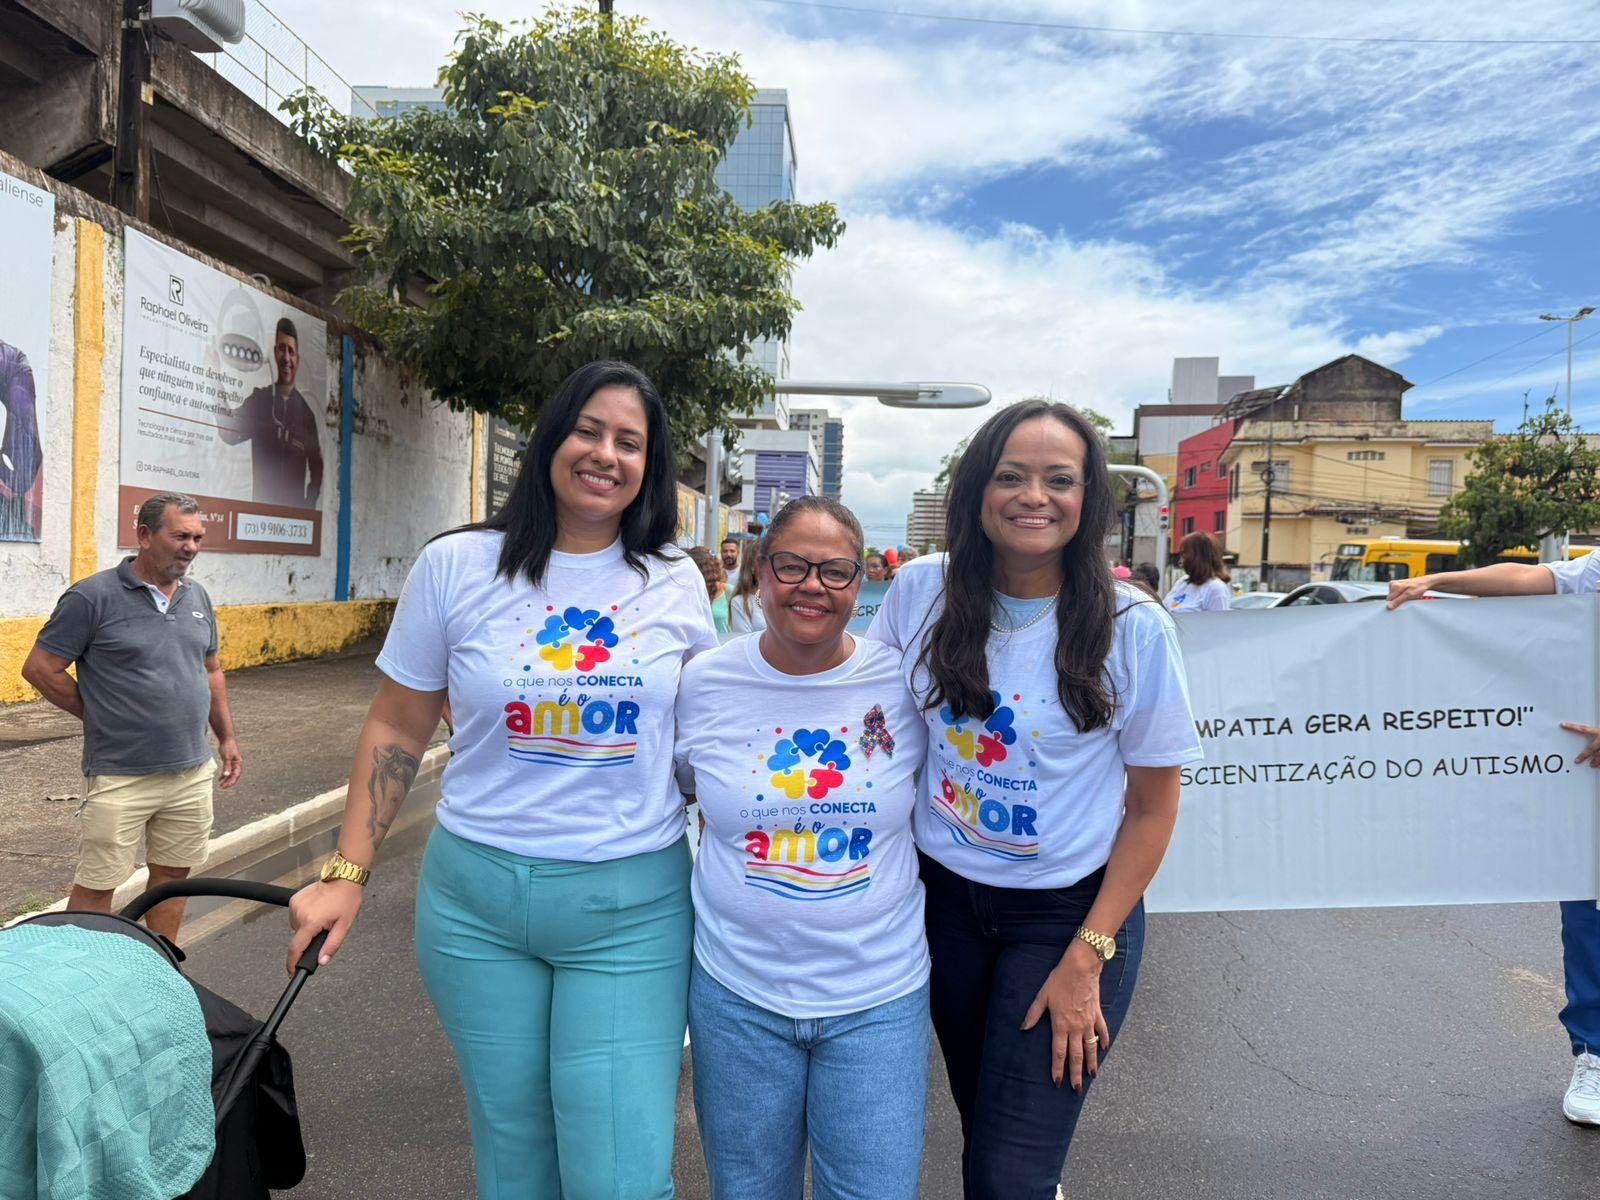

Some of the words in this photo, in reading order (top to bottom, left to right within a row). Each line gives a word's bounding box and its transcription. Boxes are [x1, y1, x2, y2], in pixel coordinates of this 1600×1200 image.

[140, 296, 177, 321] Raphael
[178, 311, 208, 333] Oliveira
[140, 345, 190, 372] Especialista
[192, 365, 204, 376] em
[205, 367, 238, 387] devolver
[238, 379, 243, 388] o
[139, 366, 155, 380] que
[157, 370, 194, 389] ninguém
[195, 381, 204, 393] vê
[206, 386, 216, 397] no
[138, 385, 181, 406] confiança
[183, 398, 188, 406] e
[244, 522, 259, 537] (73)
[260, 522, 266, 535] 9
[267, 522, 308, 538] 9106-3733
[503, 678, 512, 688] o
[516, 676, 544, 689] que
[548, 676, 573, 687] nos
[576, 675, 643, 687] CONECTA
[558, 688, 571, 706] é
[577, 692, 591, 706] o
[1305, 713, 1371, 734] GERA
[955, 763, 976, 776] nos
[977, 770, 1037, 791] CONECTA
[1180, 755, 1376, 786] SCIENTIZAÇÃO
[1386, 759, 1423, 778] DO
[1432, 754, 1570, 777] AUTISMO.
[964, 777, 972, 794] é
[740, 810, 749, 819] o
[752, 807, 779, 820] que
[782, 805, 806, 816] nos
[810, 802, 876, 814] CONECTA
[794, 817, 806, 834] é
[812, 821, 825, 834] o
